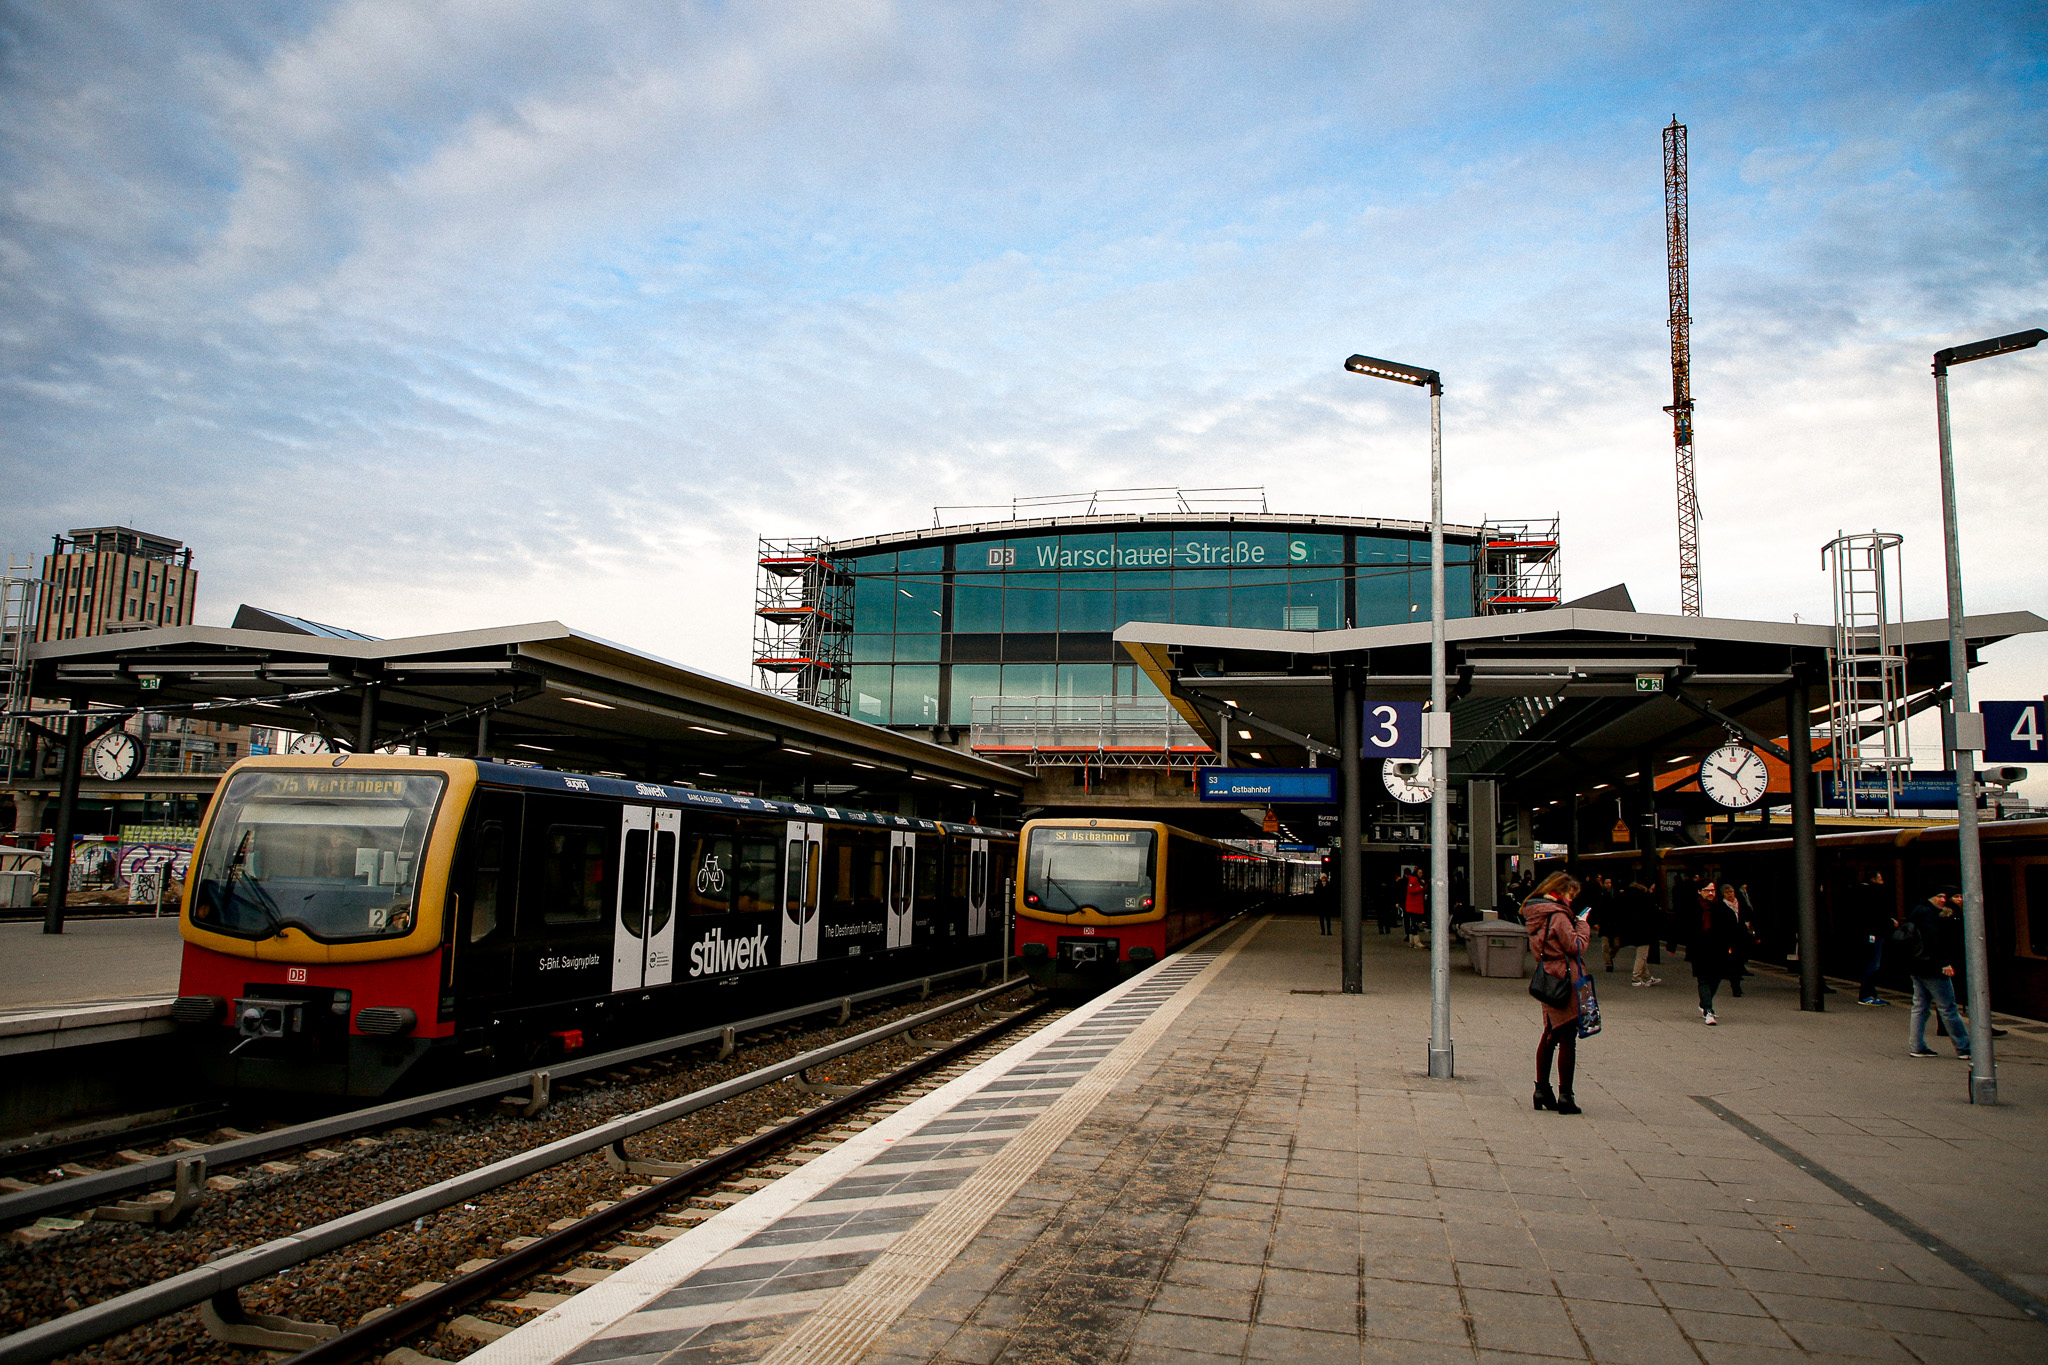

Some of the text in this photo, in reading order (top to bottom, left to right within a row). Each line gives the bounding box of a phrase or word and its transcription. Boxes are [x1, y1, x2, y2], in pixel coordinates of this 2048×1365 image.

[989, 541, 1307, 567] DB Warschauer Straße S
[1370, 705, 1399, 748] 3
[2010, 706, 2044, 750] 4
[307, 777, 401, 795] Wartenberg
[635, 782, 668, 798] stilwerk
[1659, 819, 1682, 827] Kurzzug
[1056, 832, 1131, 842] S3 Ostbahnhof
[1126, 899, 1135, 907] 54
[374, 909, 384, 927] 2
[825, 925, 834, 938] The
[835, 924, 860, 936] Destination
[689, 924, 768, 977] stilwerk
[539, 953, 600, 971] S-Bhf. Savignyplatz
[289, 969, 305, 981] DB
